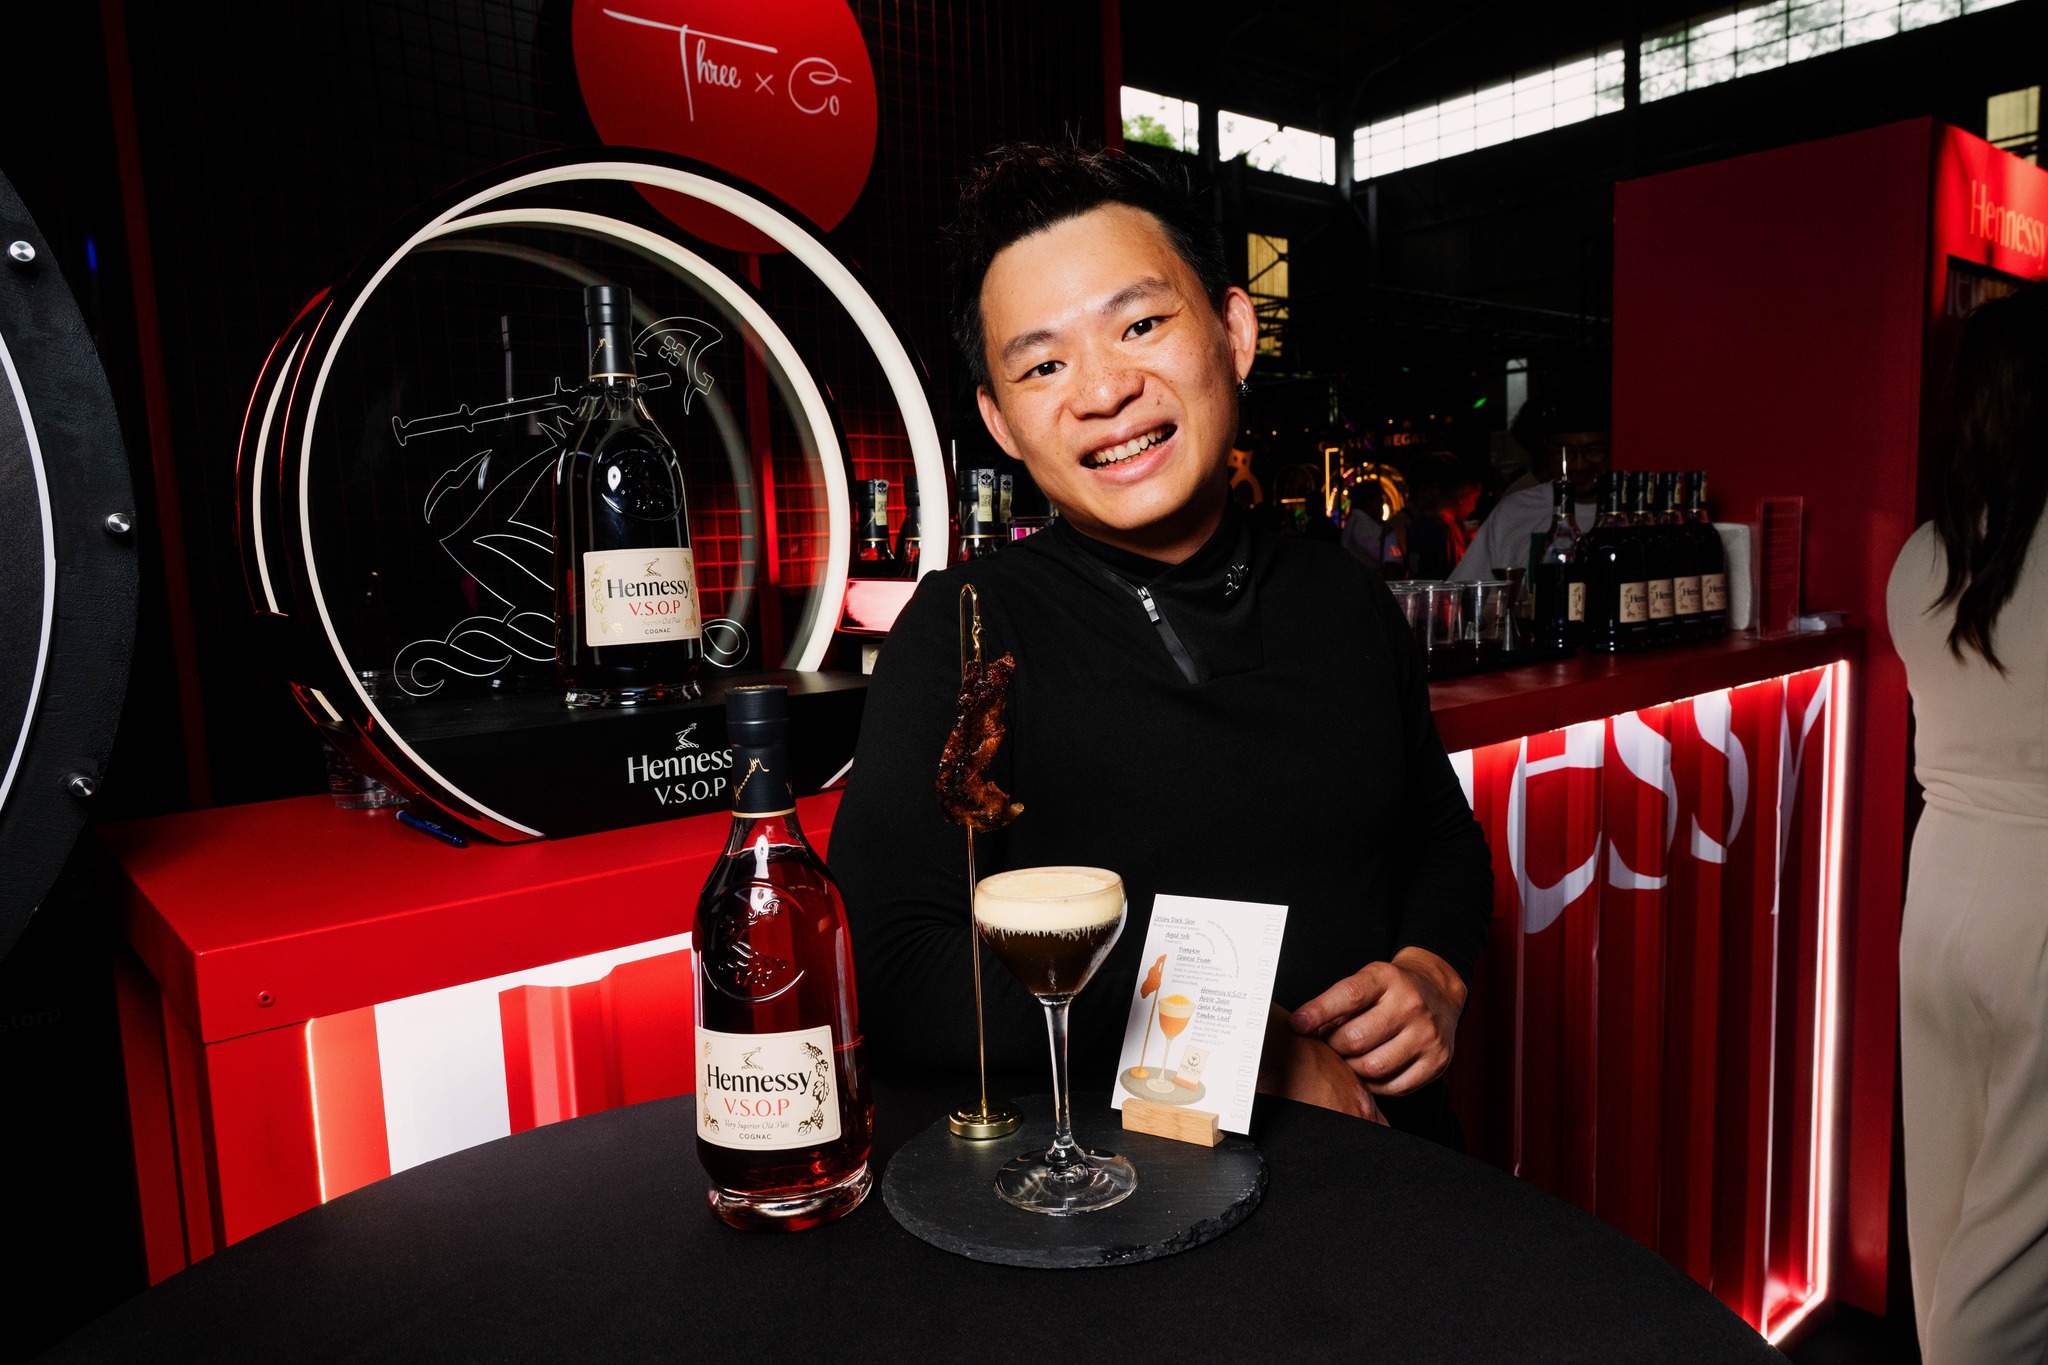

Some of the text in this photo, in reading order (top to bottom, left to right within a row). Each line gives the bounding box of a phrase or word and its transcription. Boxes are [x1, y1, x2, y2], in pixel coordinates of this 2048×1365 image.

[602, 8, 778, 122] Three
[1970, 179, 2048, 271] Hennessy
[607, 578, 690, 599] Hennessy
[628, 599, 681, 616] V.S.O.P
[644, 627, 671, 635] COGNAC
[627, 748, 733, 784] Henness
[654, 776, 727, 806] V.S.O.P
[1200, 987, 1226, 996] Hennessy
[707, 1063, 812, 1095] Hennessy
[723, 1097, 790, 1117] V.S.O.P
[737, 1120, 760, 1130] Superior
[761, 1121, 774, 1129] Old
